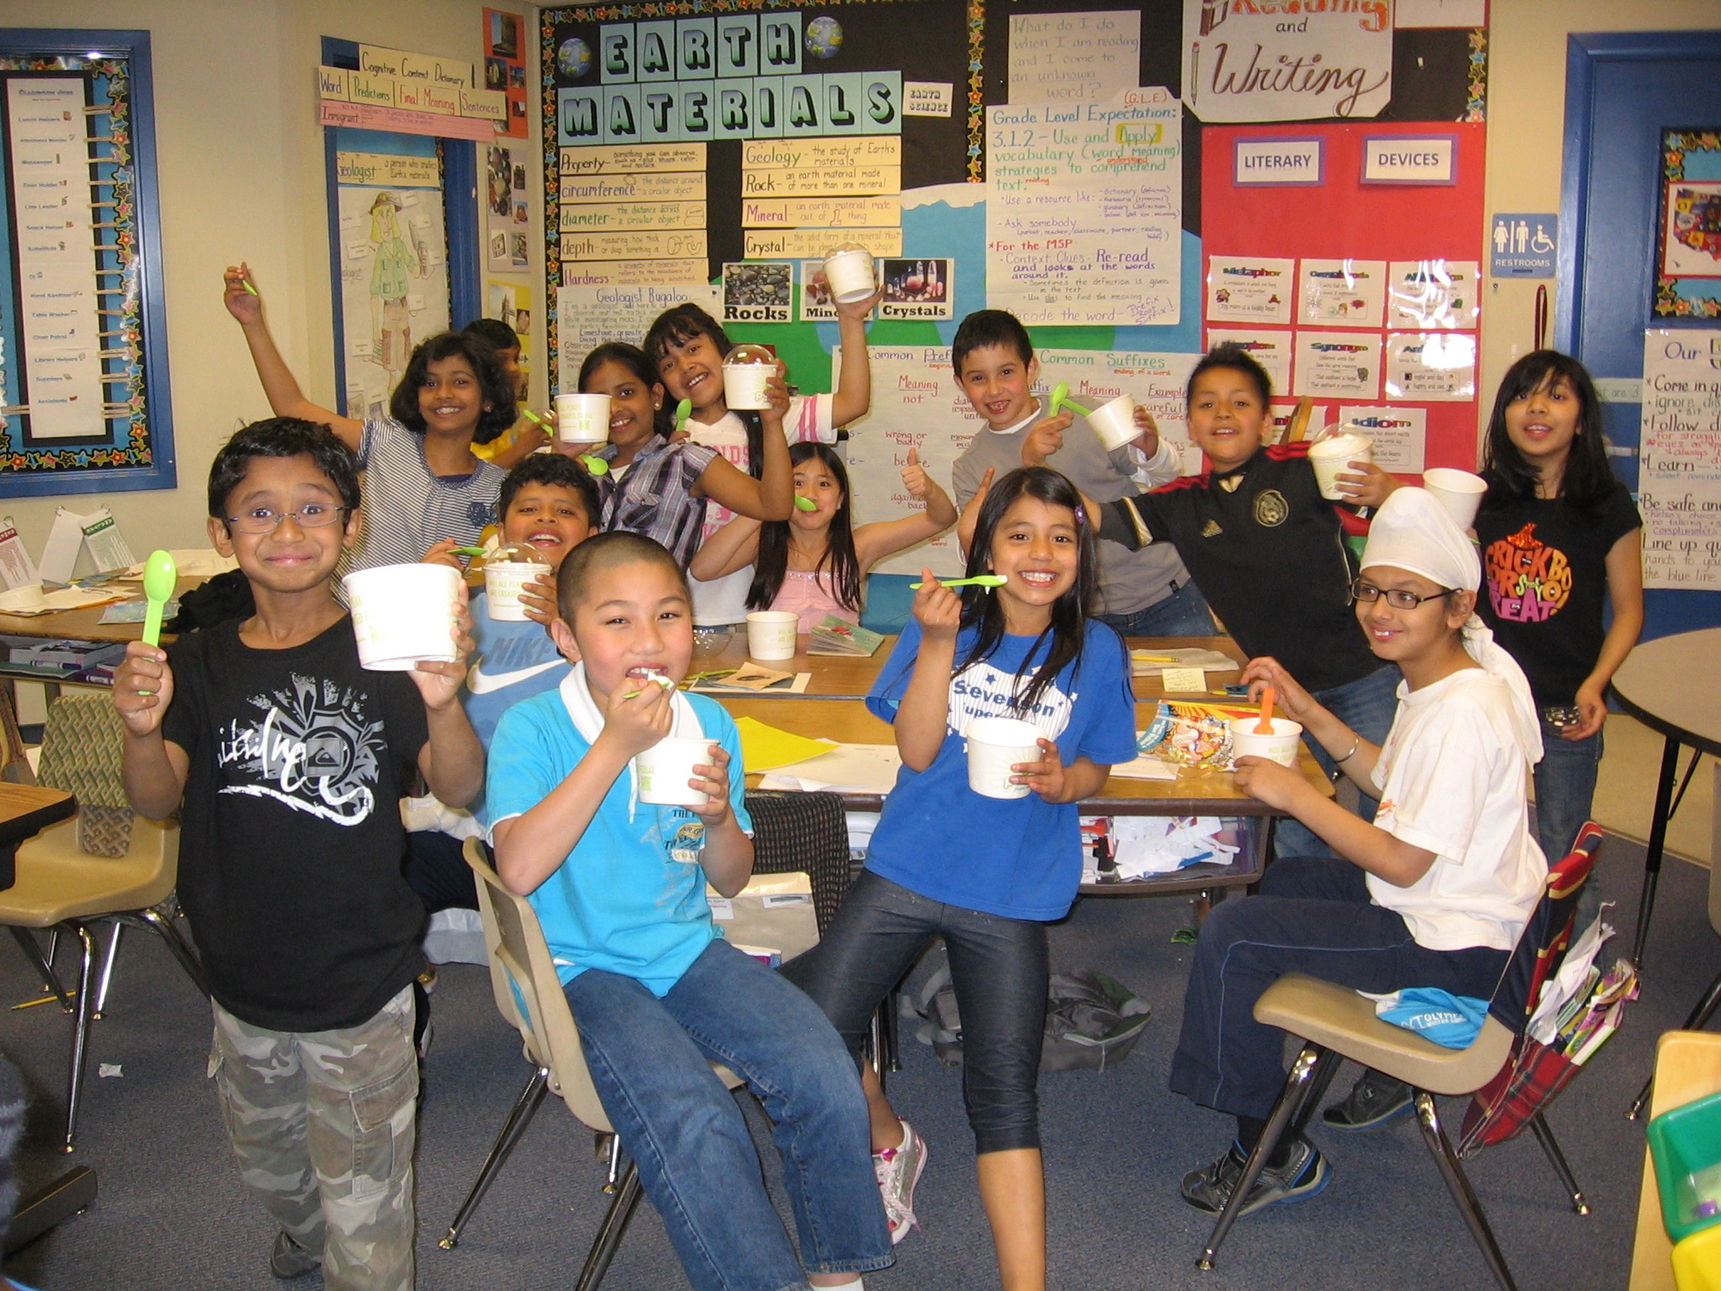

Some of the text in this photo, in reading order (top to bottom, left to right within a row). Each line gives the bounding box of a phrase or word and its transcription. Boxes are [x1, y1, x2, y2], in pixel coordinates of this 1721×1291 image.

[1013, 17, 1115, 34] What do I do
[1275, 18, 1308, 33] and
[606, 24, 796, 75] EARTH
[1013, 36, 1138, 51] when I am reading
[361, 51, 397, 77] Cognitive
[1013, 53, 1116, 66] and I come to
[1011, 68, 1096, 82] an unknown
[1212, 42, 1389, 117] Writing
[319, 72, 500, 116] Word Predictions Final Meaning Sentences
[909, 89, 941, 99] EARTH
[563, 82, 895, 137] MATERIALS
[909, 102, 948, 112] SCIENCE
[993, 104, 1177, 125] Grade Level Expectation:
[1053, 129, 1078, 144] Use
[1084, 128, 1109, 143] and
[1119, 126, 1157, 146] Apply
[811, 145, 826, 156] the
[829, 144, 850, 156] study
[853, 142, 863, 154] of
[995, 147, 1074, 165] vocabulary
[746, 146, 801, 168] Geology
[814, 154, 855, 166] materials
[1244, 155, 1312, 169] LITERARY
[1378, 153, 1440, 167] DEVICES
[785, 167, 881, 180] an earth material made
[995, 159, 1166, 179] strategies to comprehend
[788, 180, 796, 191] of
[800, 182, 818, 190] more
[822, 181, 839, 189] than
[858, 178, 886, 188] mineral
[1035, 195, 1072, 203] resource
[746, 204, 788, 222] Mineral
[1005, 216, 1077, 230] Ask somebody
[1021, 241, 1039, 251] the
[1046, 239, 1073, 250] MSP
[1005, 247, 1149, 265] Context Clues Re-read
[1495, 258, 1551, 267] RESTROOMS
[1013, 263, 1037, 272] and
[1080, 263, 1093, 271] at
[1101, 262, 1118, 271] the
[1125, 262, 1156, 270] words
[1012, 272, 1049, 280] around
[596, 287, 642, 309] Geologist
[723, 306, 788, 321] Rocks
[805, 307, 869, 318] Mines
[882, 304, 946, 317] Crystals
[1062, 307, 1080, 321] the
[1086, 307, 1116, 321] word
[1310, 342, 1369, 354] Synonym
[1664, 341, 1702, 360] Our
[1040, 350, 1166, 369] Common Suffixes
[898, 375, 939, 397] Meaning
[1026, 379, 1051, 393] uffix
[1079, 380, 1121, 396] Meaning
[1654, 373, 1689, 391] Come
[1694, 381, 1707, 392] in
[902, 395, 924, 403] not
[1352, 417, 1412, 429] Idiom
[885, 431, 913, 440] wrong
[1646, 453, 1695, 472] Learn
[1643, 492, 1696, 511] Be safe
[1642, 532, 1698, 556] Line up
[1667, 567, 1690, 581] blue
[1696, 569, 1717, 581] line
